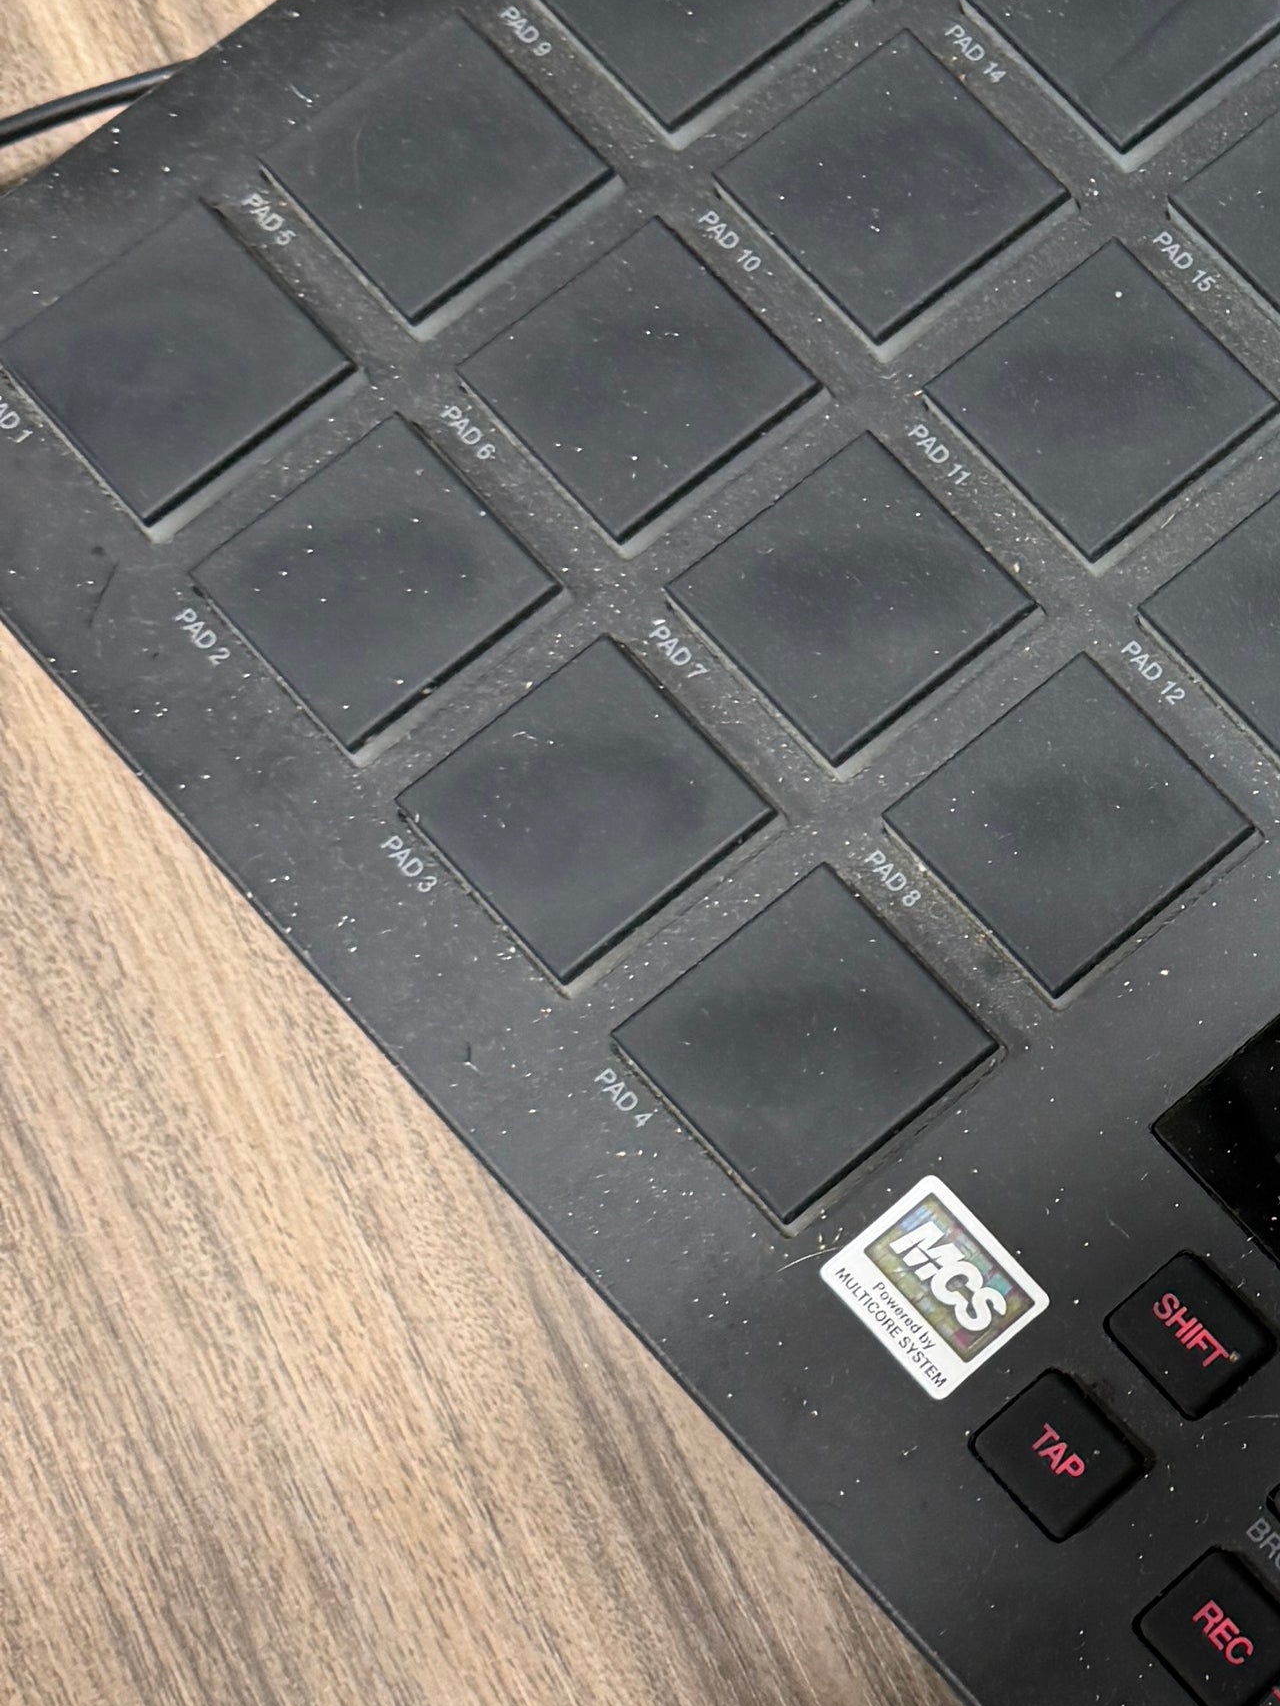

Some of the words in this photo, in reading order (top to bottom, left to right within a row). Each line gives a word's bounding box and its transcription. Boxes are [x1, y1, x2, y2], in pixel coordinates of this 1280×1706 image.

[241, 192, 282, 232] PAD
[276, 227, 297, 246] 5
[699, 210, 742, 252] PAD
[736, 247, 761, 273] 10
[441, 404, 482, 447] PAD
[477, 442, 495, 461] 6
[173, 607, 217, 651] PAD
[209, 645, 232, 667] 2
[379, 835, 424, 879] PAD
[418, 872, 440, 895] 3
[594, 1067, 639, 1112] PAD
[632, 1105, 655, 1129] 4
[889, 1220, 1008, 1332] MCS
[834, 1267, 901, 1339] MULTICORE
[898, 1332, 947, 1389] SYSTEM
[872, 1281, 930, 1342] Powered
[919, 1328, 937, 1350] by
[1152, 1292, 1230, 1368] SHIFT
[1030, 1422, 1086, 1479] TAP
[1192, 1599, 1255, 1667] REC
